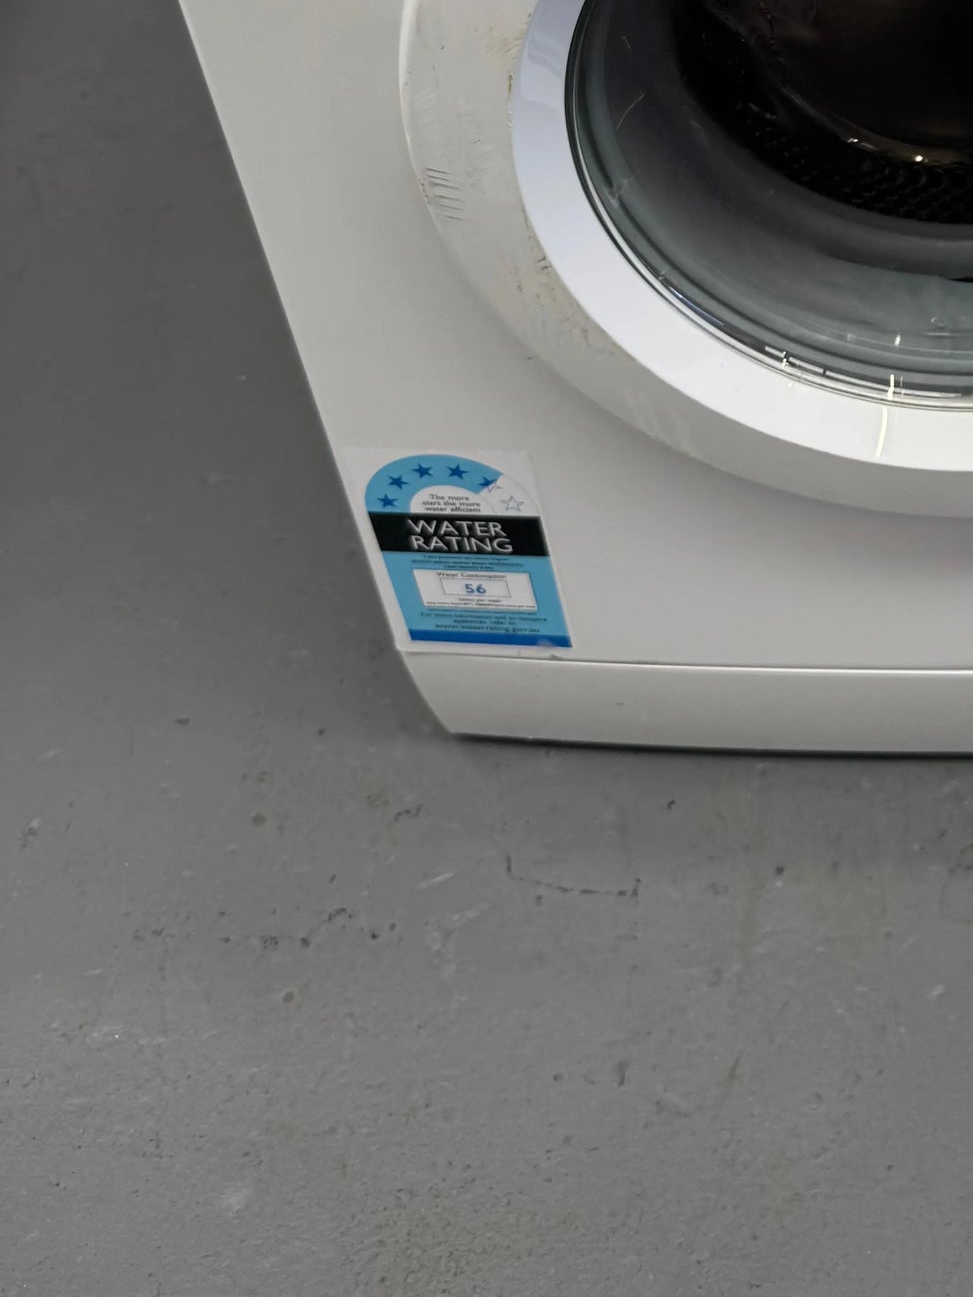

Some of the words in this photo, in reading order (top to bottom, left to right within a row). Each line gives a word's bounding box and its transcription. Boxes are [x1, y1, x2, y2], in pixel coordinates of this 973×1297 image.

[408, 519, 507, 536] WATER
[410, 535, 513, 552] RATING
[464, 583, 487, 594] 56
